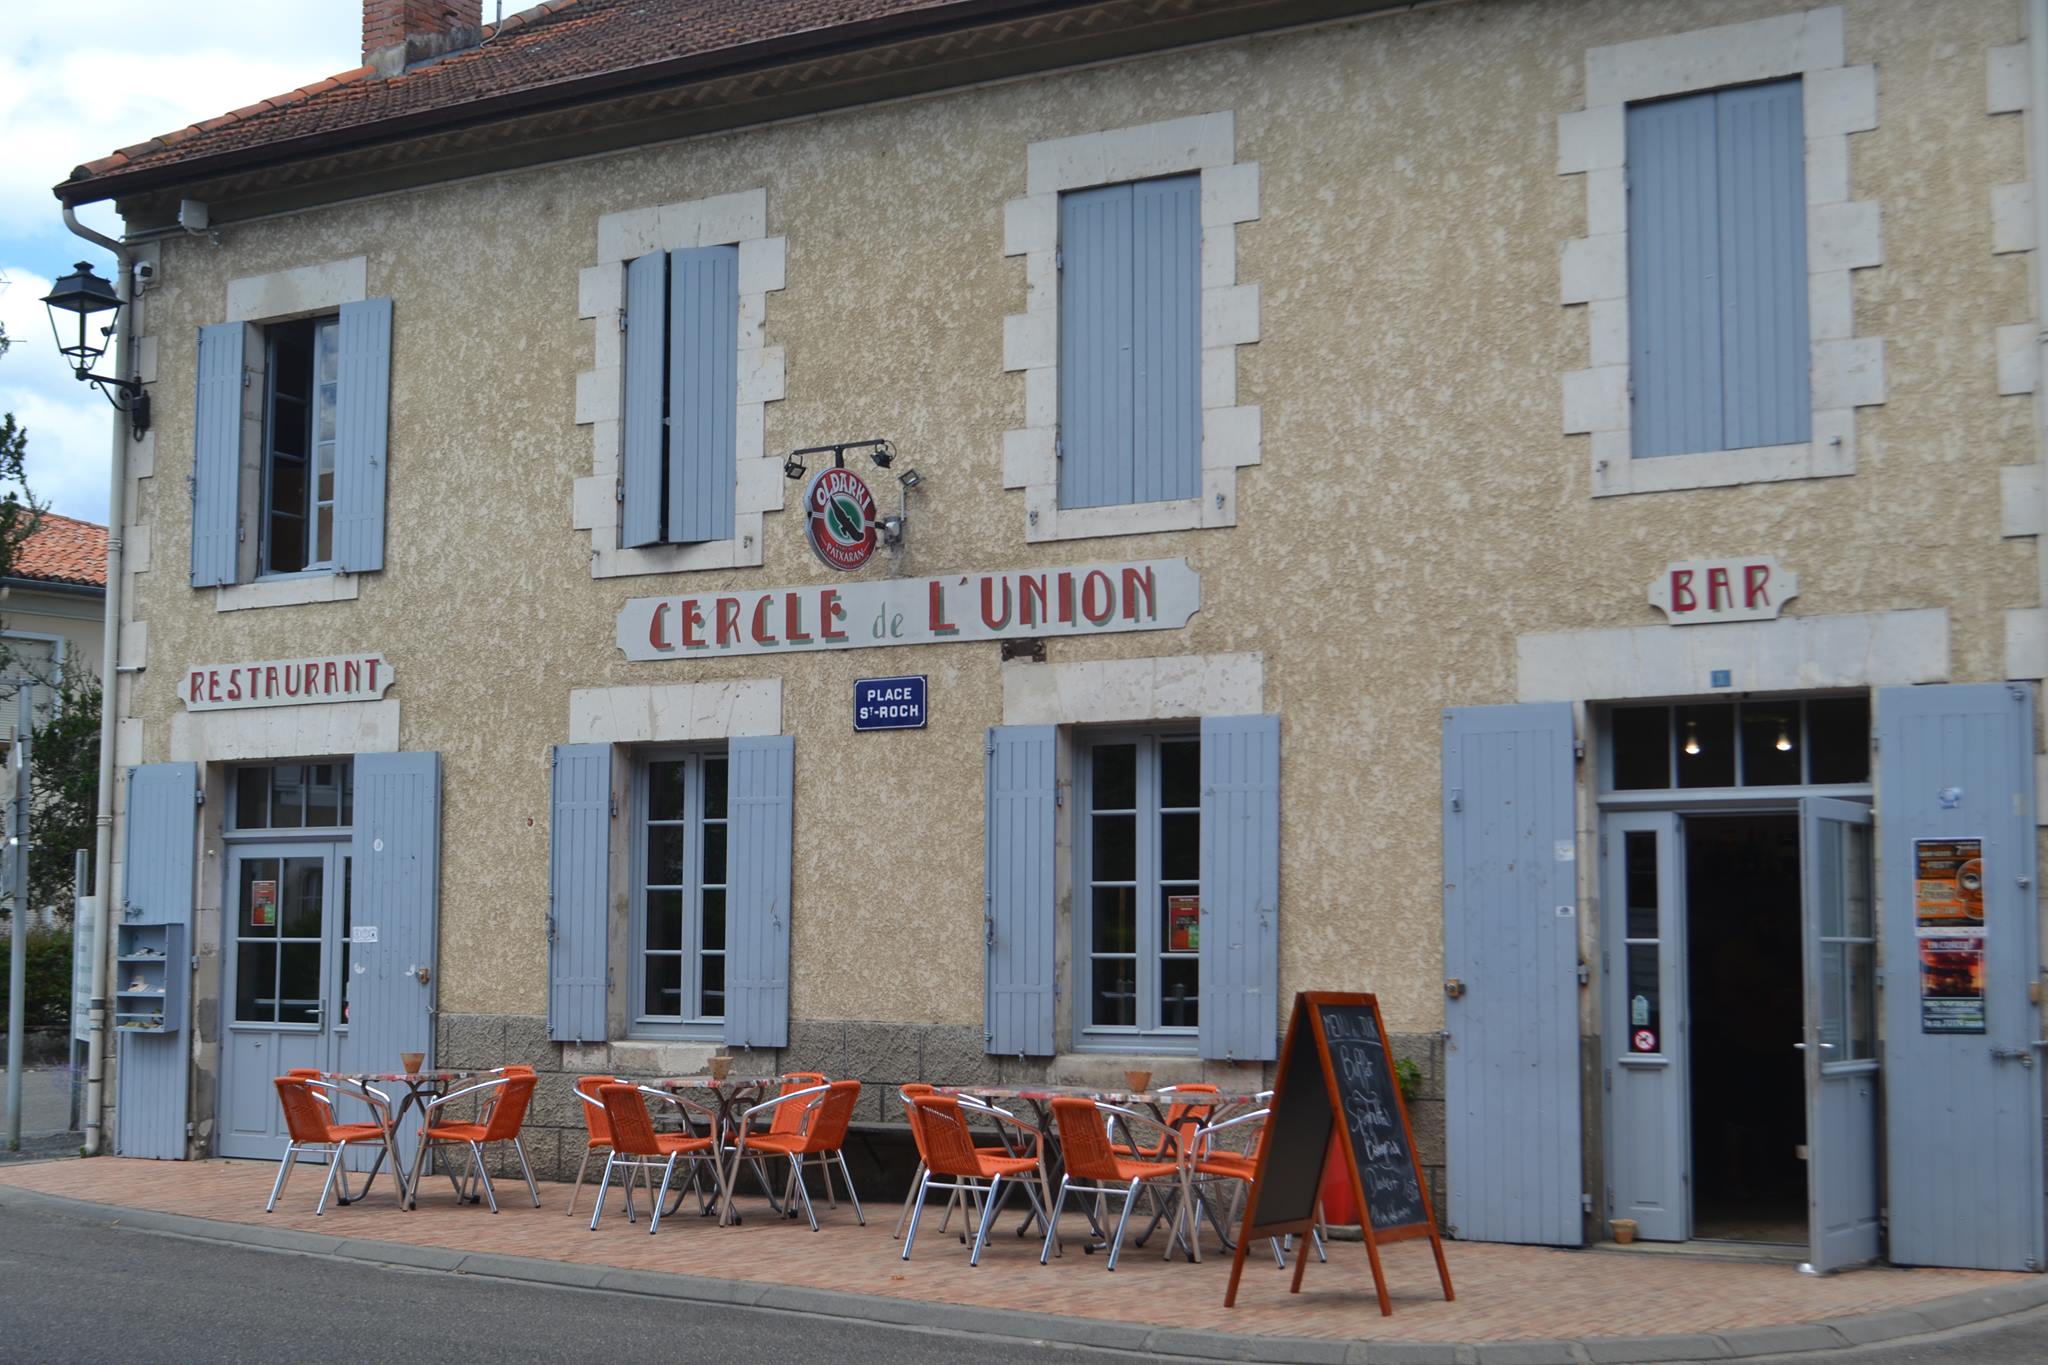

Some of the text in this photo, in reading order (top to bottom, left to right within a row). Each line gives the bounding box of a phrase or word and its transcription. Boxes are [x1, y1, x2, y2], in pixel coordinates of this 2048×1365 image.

[816, 473, 871, 511] OLDARKI
[826, 543, 865, 562] PATXARAN
[649, 566, 1157, 652] CERCLE de L'UNION
[1670, 565, 1771, 614] BAR
[190, 659, 382, 704] RESTAURANT
[867, 687, 912, 702] PLACE
